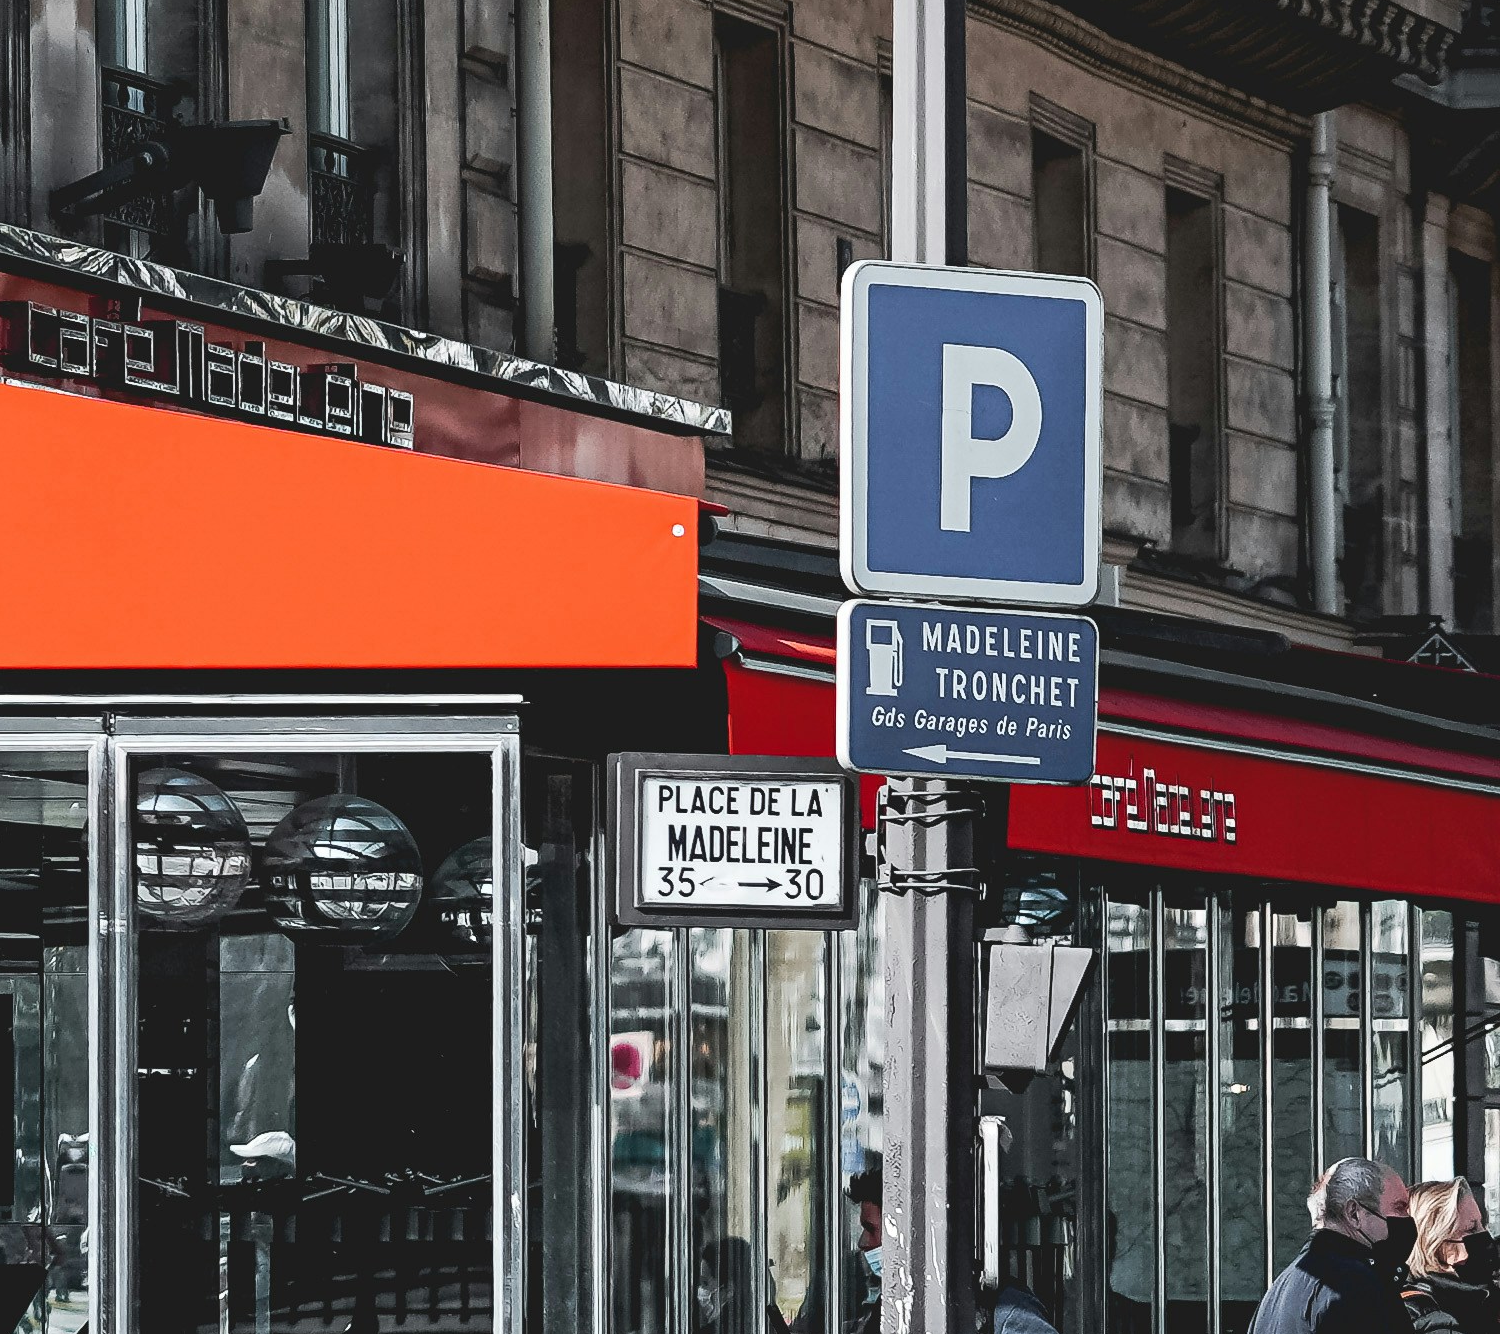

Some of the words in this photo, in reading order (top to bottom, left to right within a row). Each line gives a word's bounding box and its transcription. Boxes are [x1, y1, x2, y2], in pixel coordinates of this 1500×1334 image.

[940, 343, 1044, 533] P
[922, 621, 1082, 663] MADELEINE
[935, 667, 1080, 708] TRONCHET
[871, 705, 906, 728] Gds
[914, 709, 989, 738] Garages
[996, 715, 1017, 736] de
[1025, 717, 1072, 740] Paris
[658, 784, 740, 815] PLACE
[750, 786, 781, 816] DE
[791, 788, 823, 818] LA
[667, 823, 814, 865] MADELEINE
[658, 866, 696, 898] 35
[784, 868, 824, 901] 30
